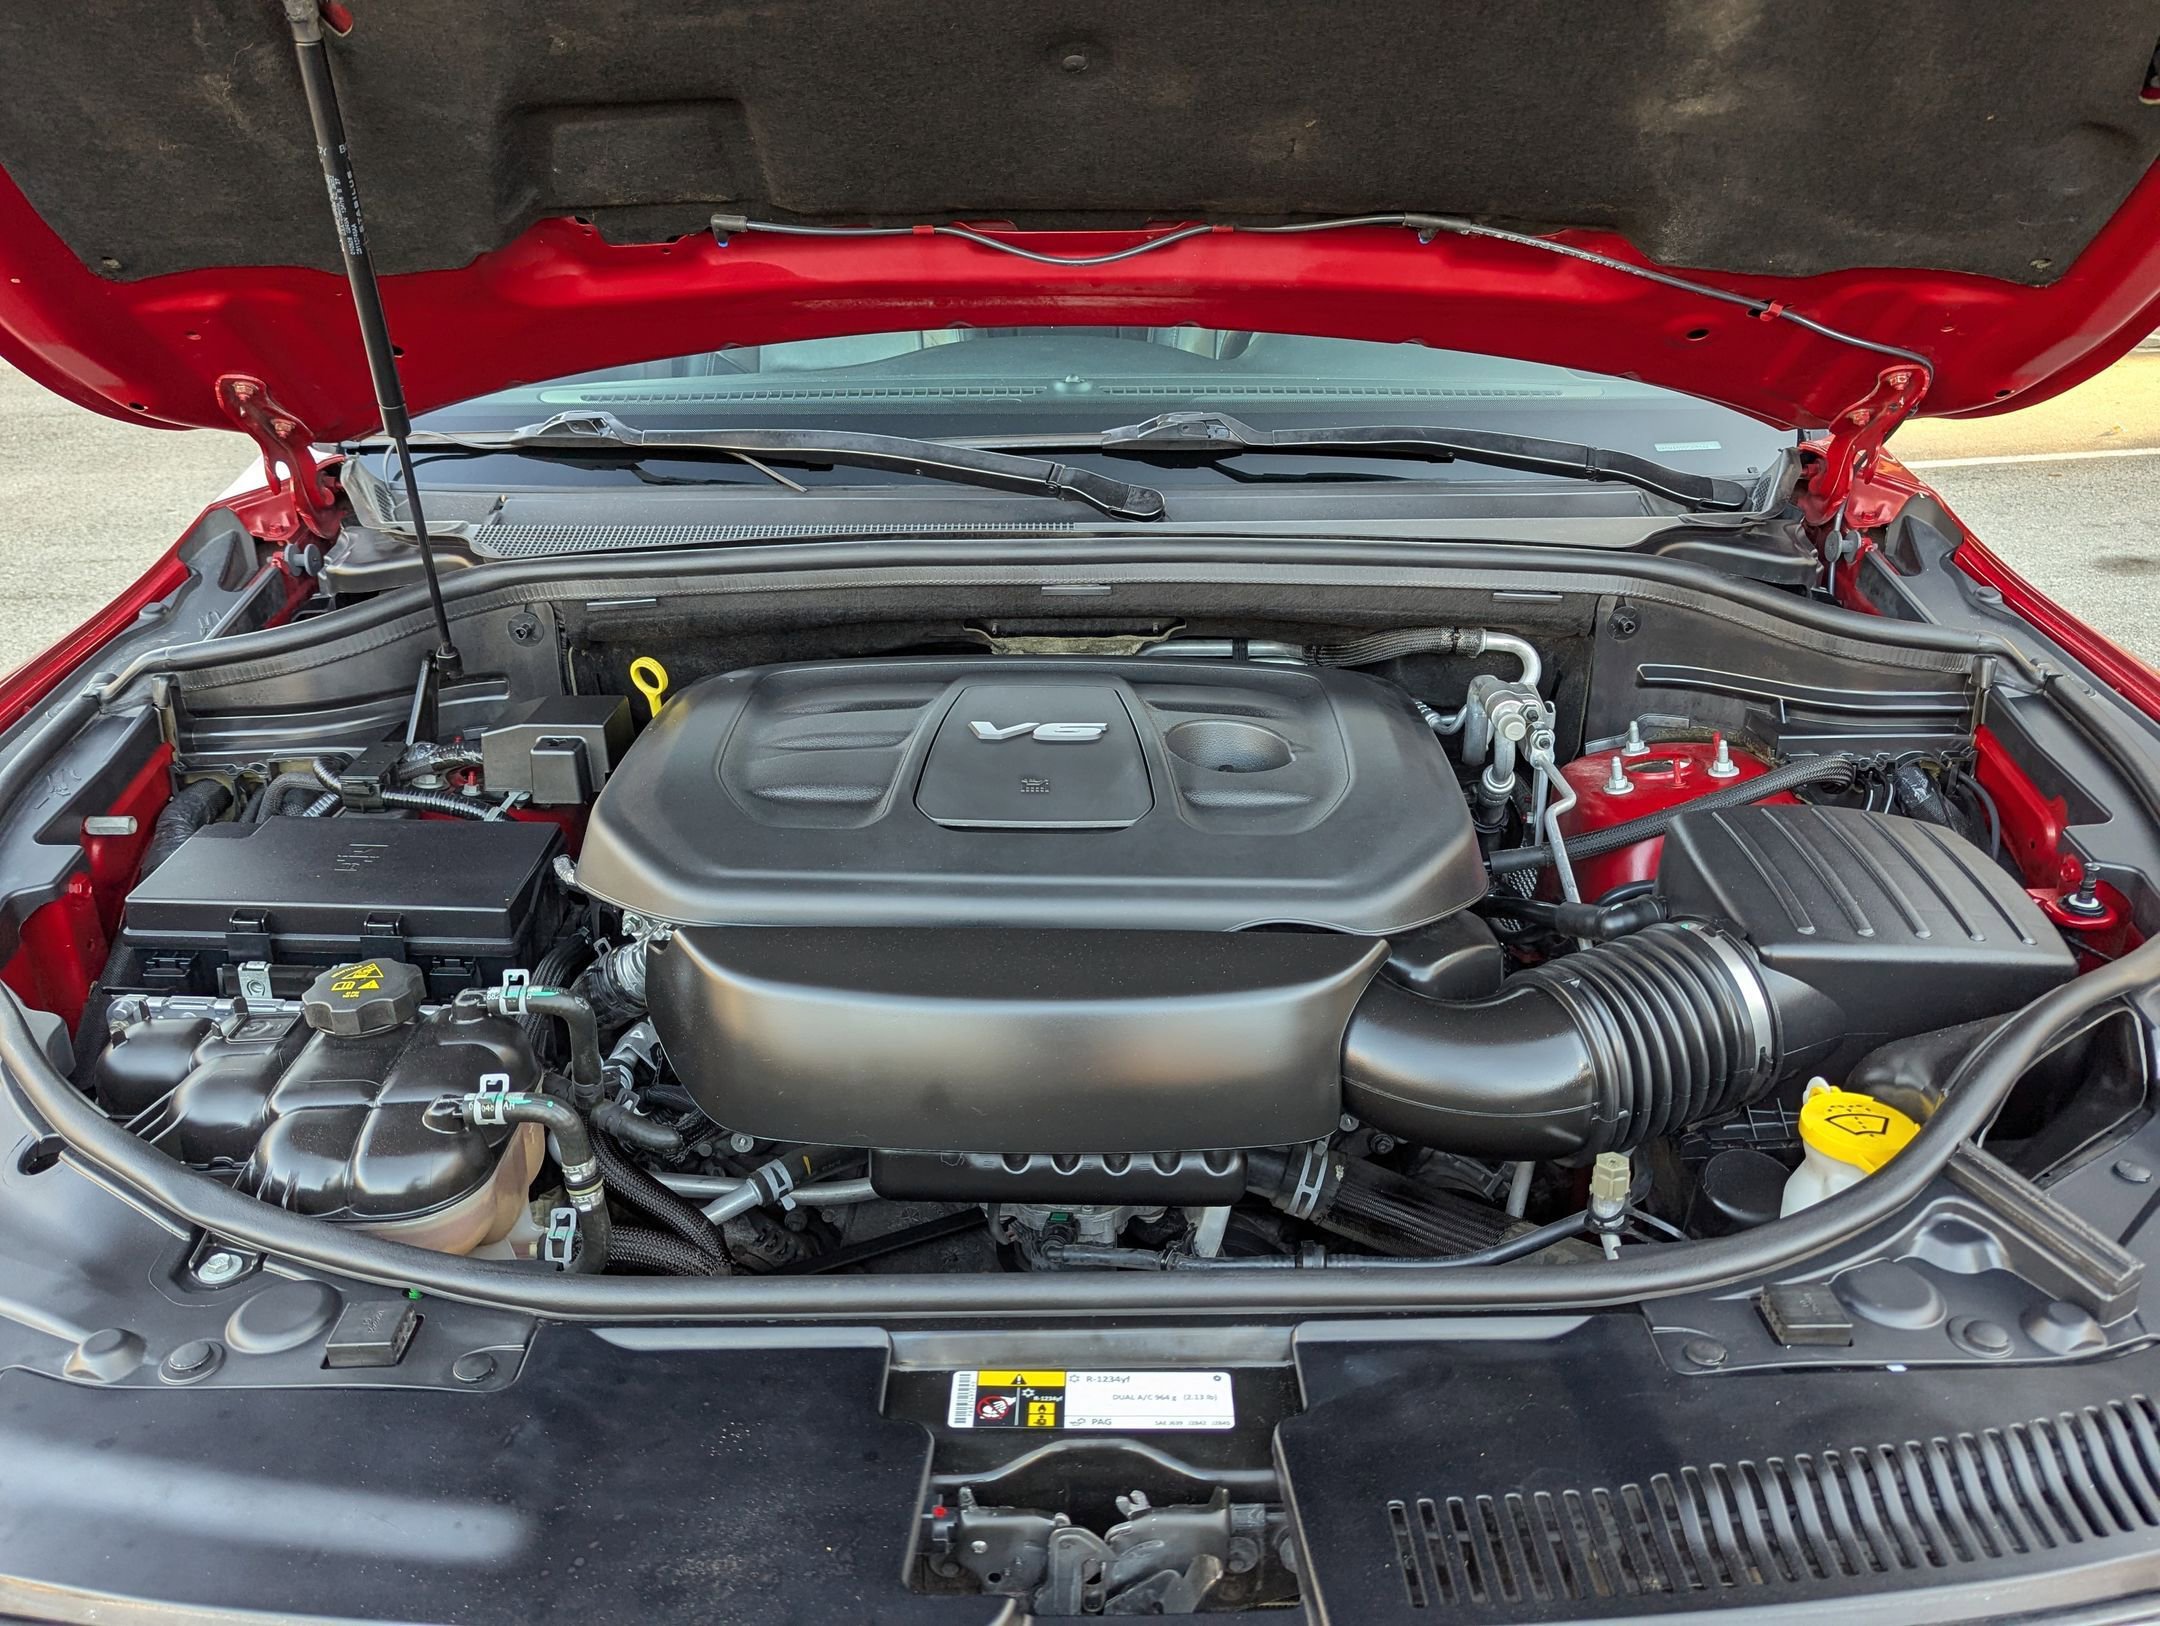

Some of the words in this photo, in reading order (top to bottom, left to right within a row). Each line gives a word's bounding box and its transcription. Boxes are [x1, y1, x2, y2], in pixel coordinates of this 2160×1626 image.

[347, 170, 364, 233] STABILUS
[968, 721, 1107, 740] V6
[1086, 1375, 1131, 1384] R-1234yf
[1091, 1418, 1113, 1426] PAG
